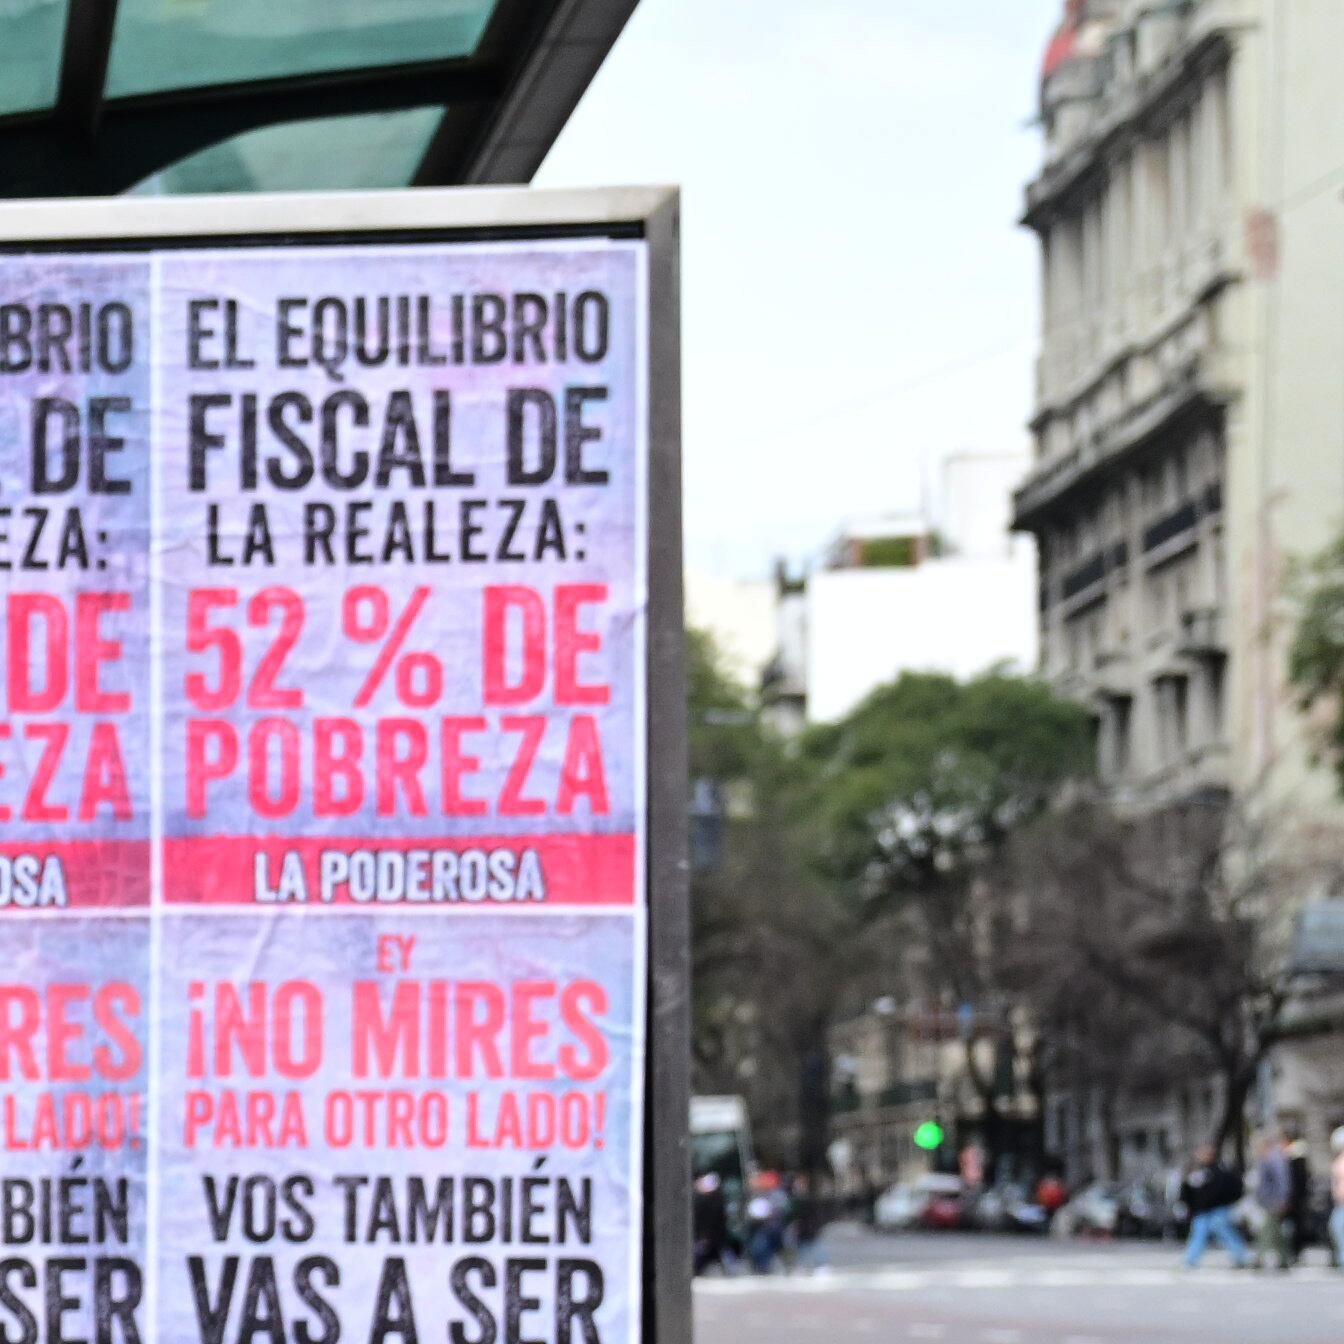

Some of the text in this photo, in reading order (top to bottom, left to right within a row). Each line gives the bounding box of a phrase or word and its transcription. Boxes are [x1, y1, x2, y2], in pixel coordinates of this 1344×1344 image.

[190, 291, 608, 380] EL EQUILIBRIO
[32, 397, 131, 495] DE
[190, 387, 608, 491] FISCAL DE
[208, 499, 583, 564] LA REALEZA:
[6, 591, 132, 714] DE
[185, 582, 611, 712] 52 % DE
[186, 714, 611, 820] POBREZA
[256, 851, 543, 901] LA PODEROSA
[378, 935, 415, 972] EY
[188, 979, 608, 1080] ¡NO MIRES
[5, 1093, 139, 1151] LADO!
[185, 1090, 605, 1149] PARA OTRO LADO!
[204, 1158, 591, 1244] VOS TAMBIÉN
